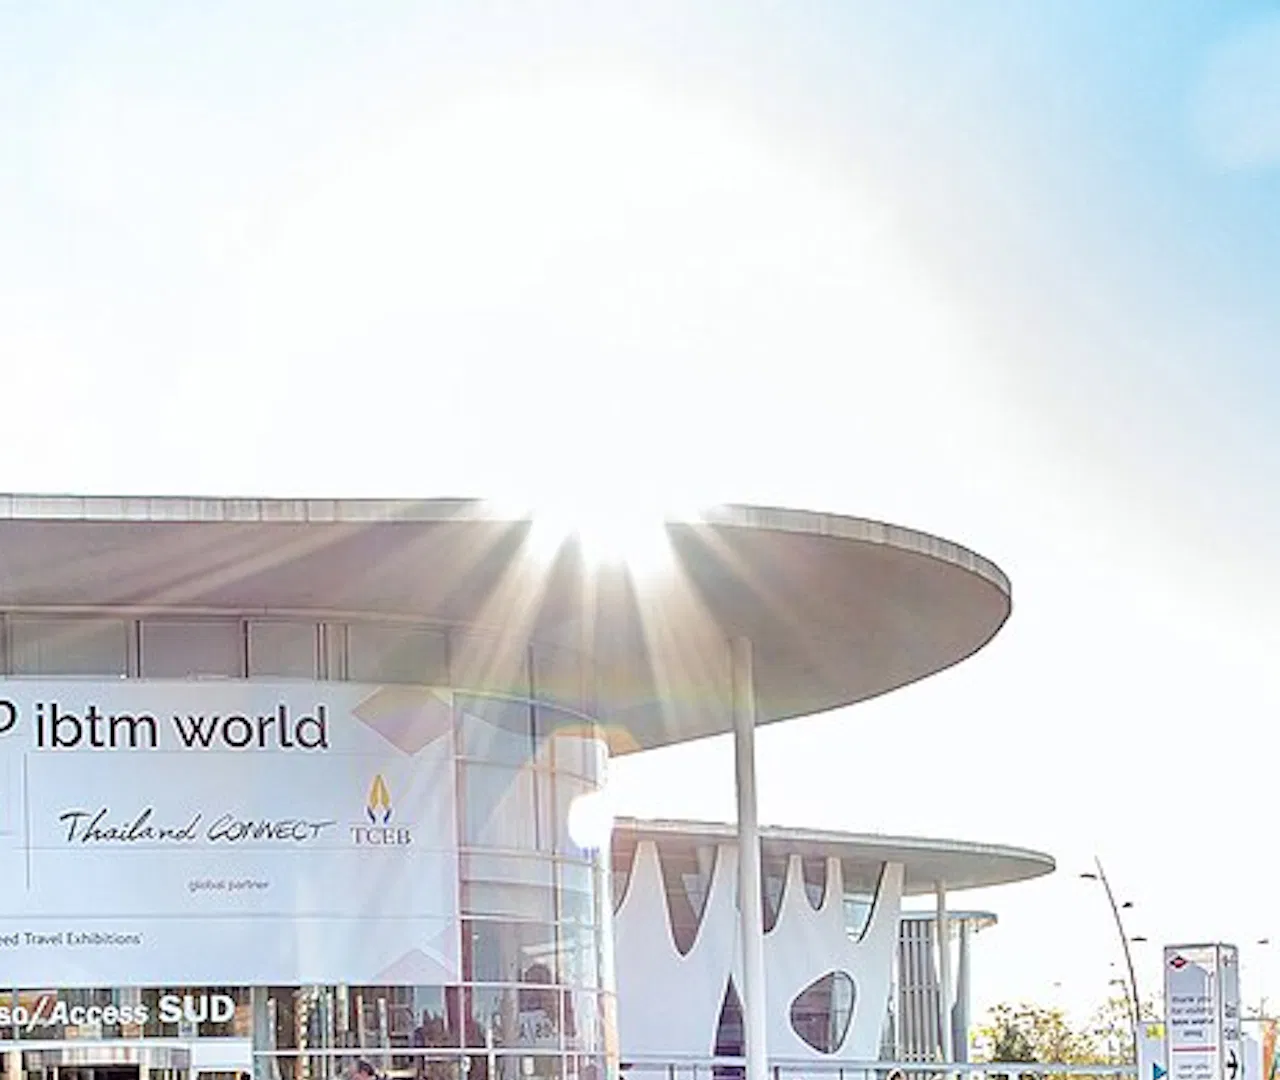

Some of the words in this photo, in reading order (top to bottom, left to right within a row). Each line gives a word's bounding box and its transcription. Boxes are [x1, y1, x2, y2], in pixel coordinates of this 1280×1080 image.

[35, 702, 158, 748] ibtm
[173, 704, 329, 749] world
[59, 807, 202, 843] Thailand
[349, 825, 413, 845] TCEB
[23, 931, 64, 946] Travel
[66, 931, 140, 946] Exhibitions
[157, 994, 236, 1024] SUD
